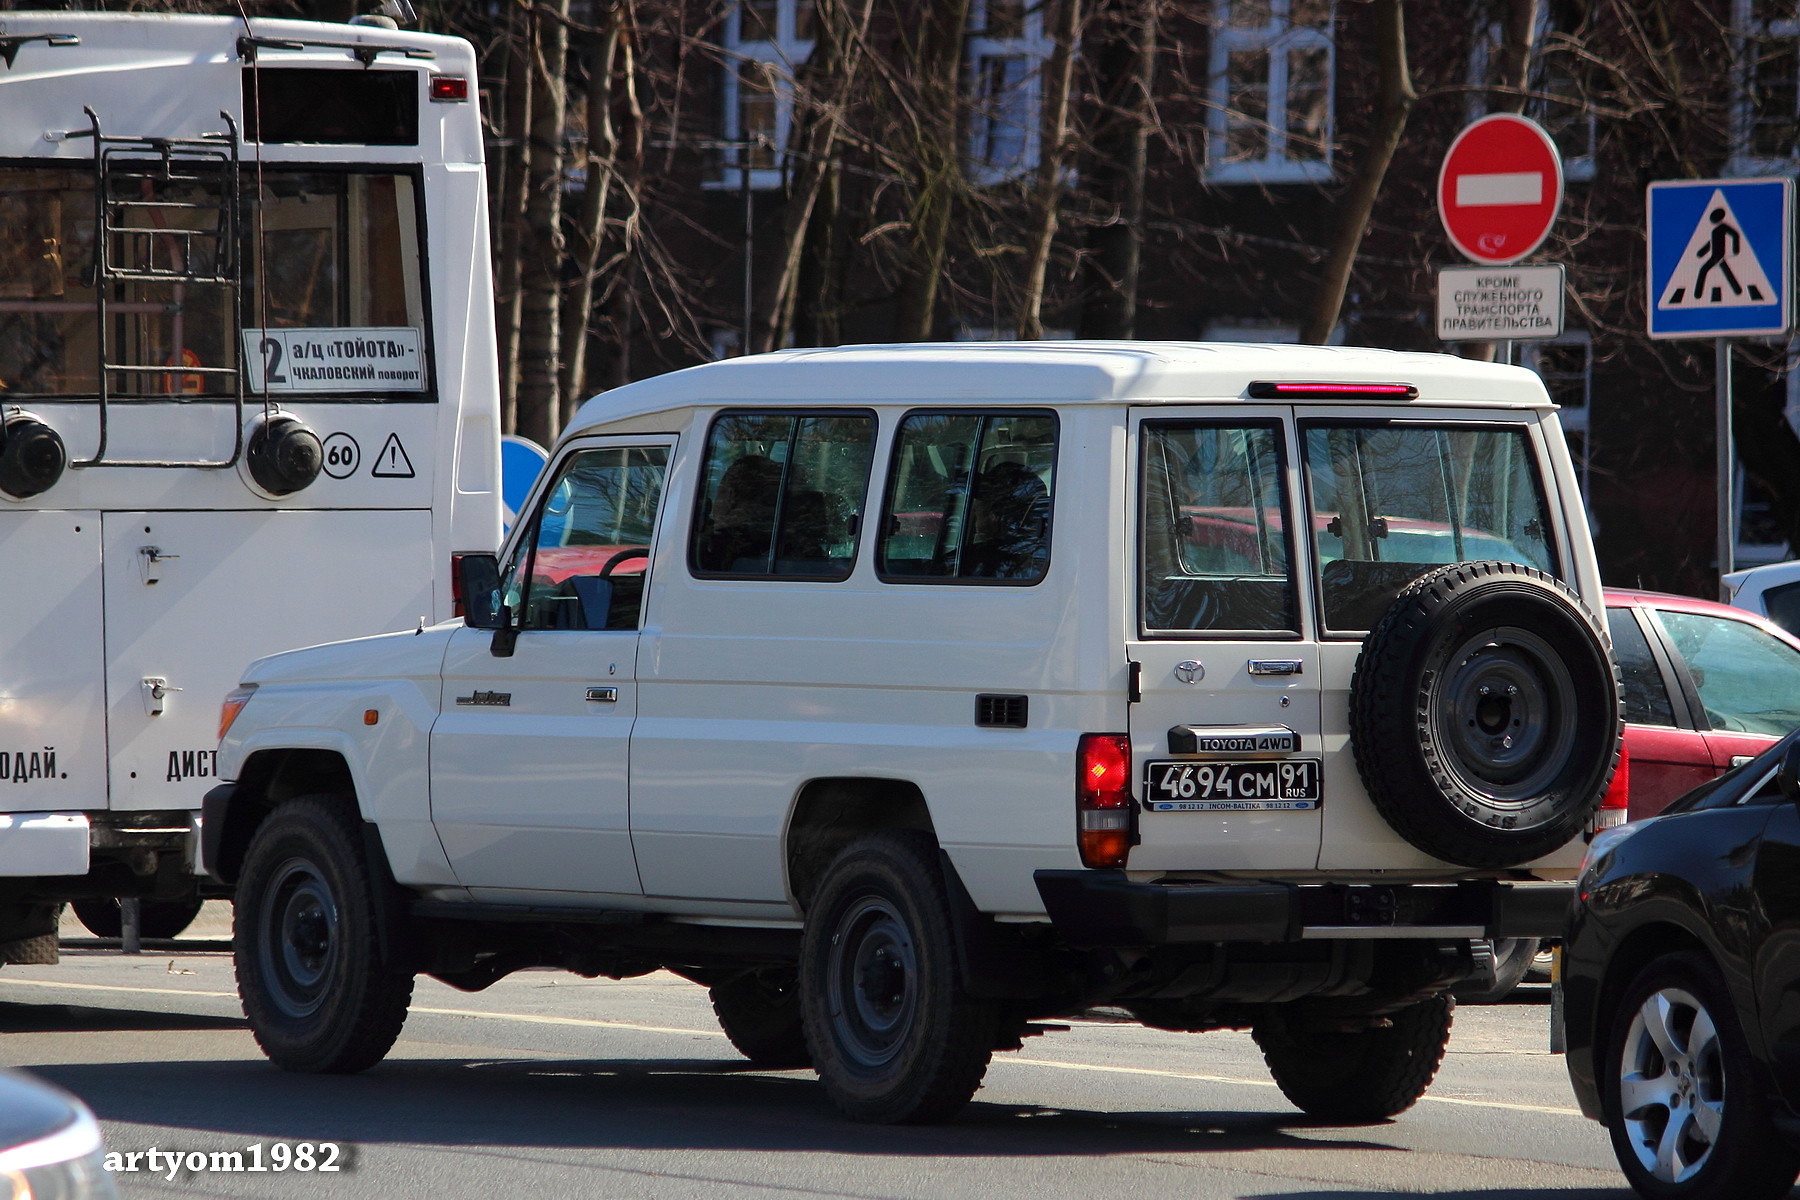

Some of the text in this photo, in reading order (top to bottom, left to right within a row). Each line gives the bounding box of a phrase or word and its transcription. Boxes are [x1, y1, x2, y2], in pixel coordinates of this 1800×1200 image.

[1476, 277, 1520, 288] КРОМЕ
[1454, 290, 1543, 303] СЛУЖЕБНОГО
[1457, 303, 1539, 315] ТРАНСПОРТА
[1443, 317, 1552, 330] ПРАВИТЕЛЬСТВА
[259, 337, 287, 383] 2
[292, 364, 420, 381] ЧКАЛОВСКИЙ поворот
[327, 445, 353, 466] 60
[1202, 738, 1292, 750] TOYOTA 4WD
[1160, 766, 1233, 798] 4694
[1281, 764, 1309, 788] 91
[1285, 788, 1306, 797] RUS
